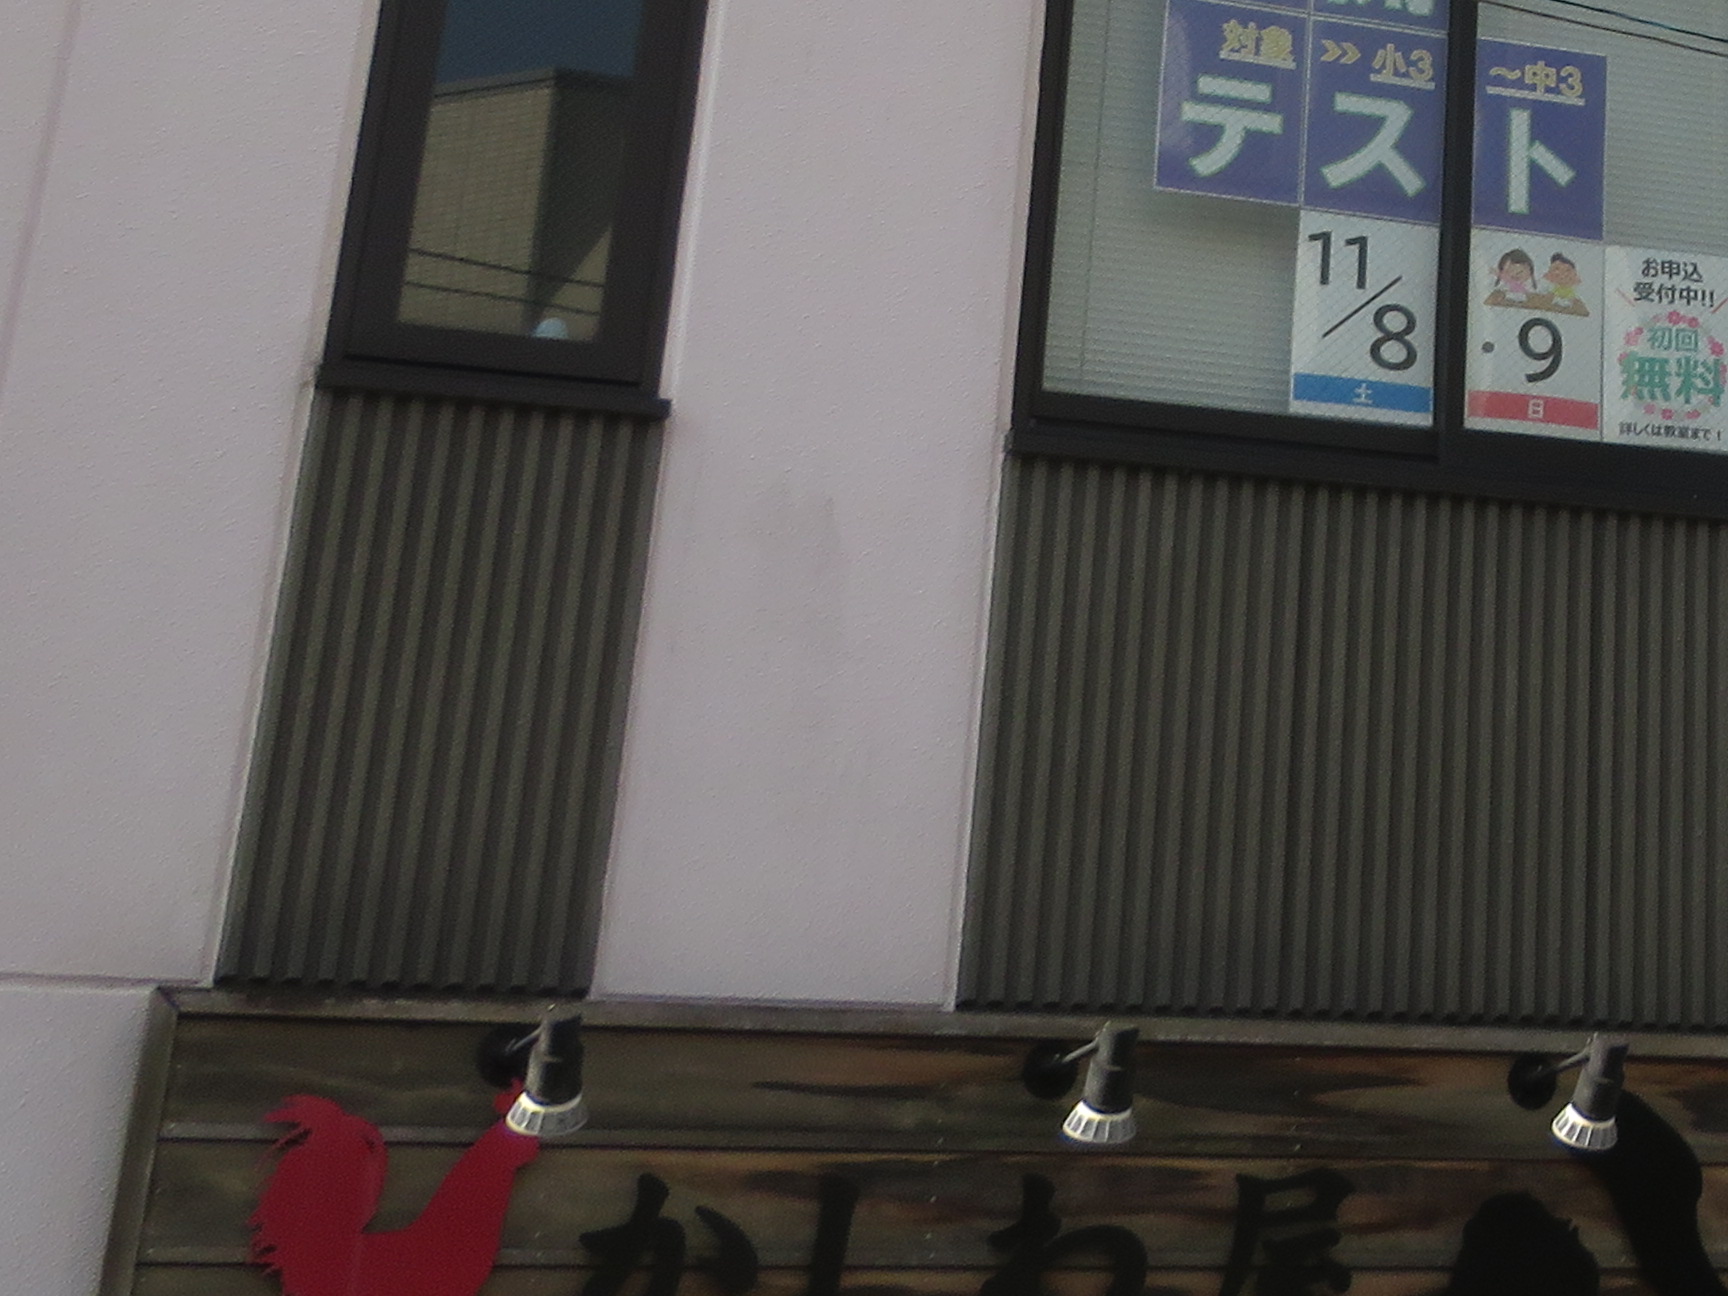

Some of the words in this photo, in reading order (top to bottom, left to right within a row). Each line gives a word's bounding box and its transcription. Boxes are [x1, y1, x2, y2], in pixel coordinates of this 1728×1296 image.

[1181, 74, 1575, 214] テスト
[1641, 258, 1703, 283] お申込
[1648, 326, 1699, 353] 初回
[1619, 351, 1725, 407] 無料
